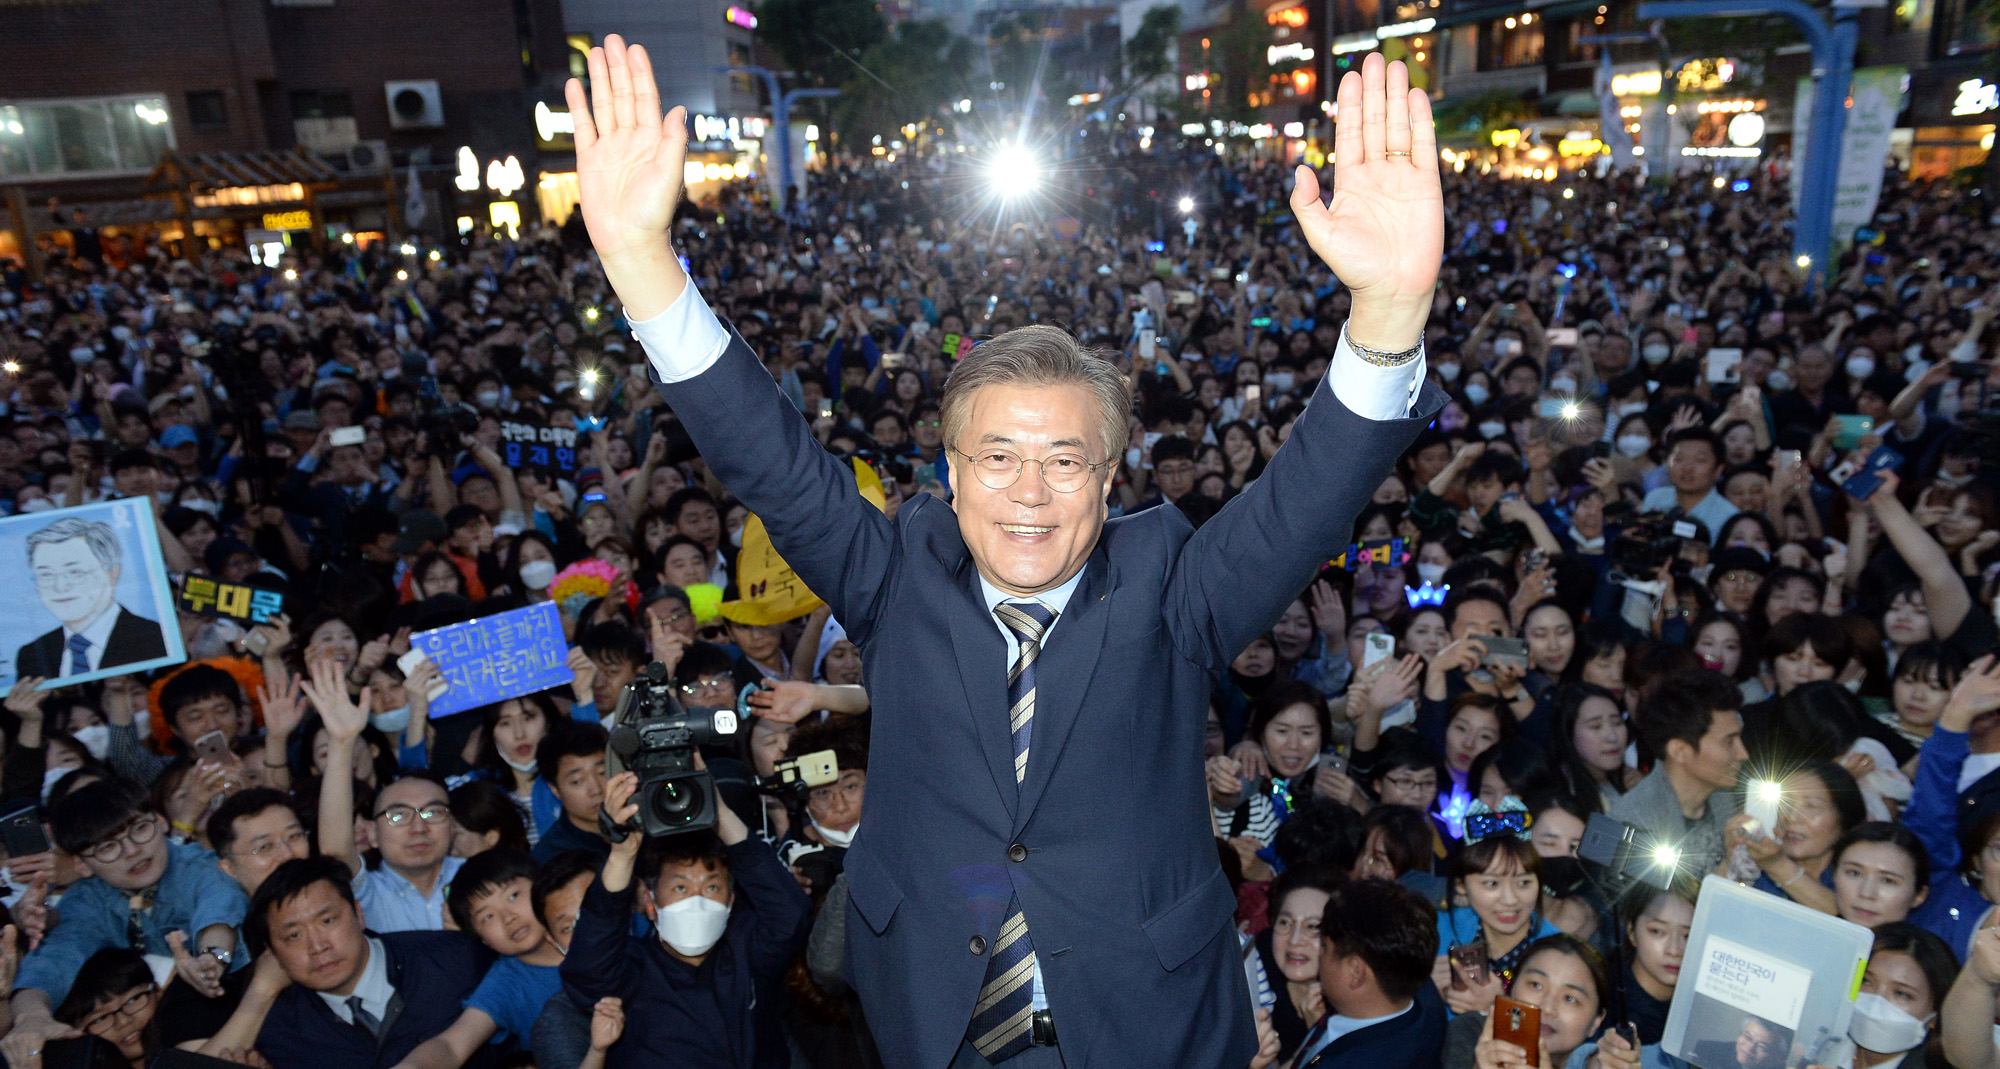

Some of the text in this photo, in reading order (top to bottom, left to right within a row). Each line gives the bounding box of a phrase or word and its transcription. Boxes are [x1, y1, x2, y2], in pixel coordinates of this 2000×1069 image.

[428, 607, 553, 665] 우리가 끝까지
[443, 636, 566, 696] 지켜줄게요
[716, 716, 734, 728] KTV
[1712, 950, 1777, 984] 대한민국이
